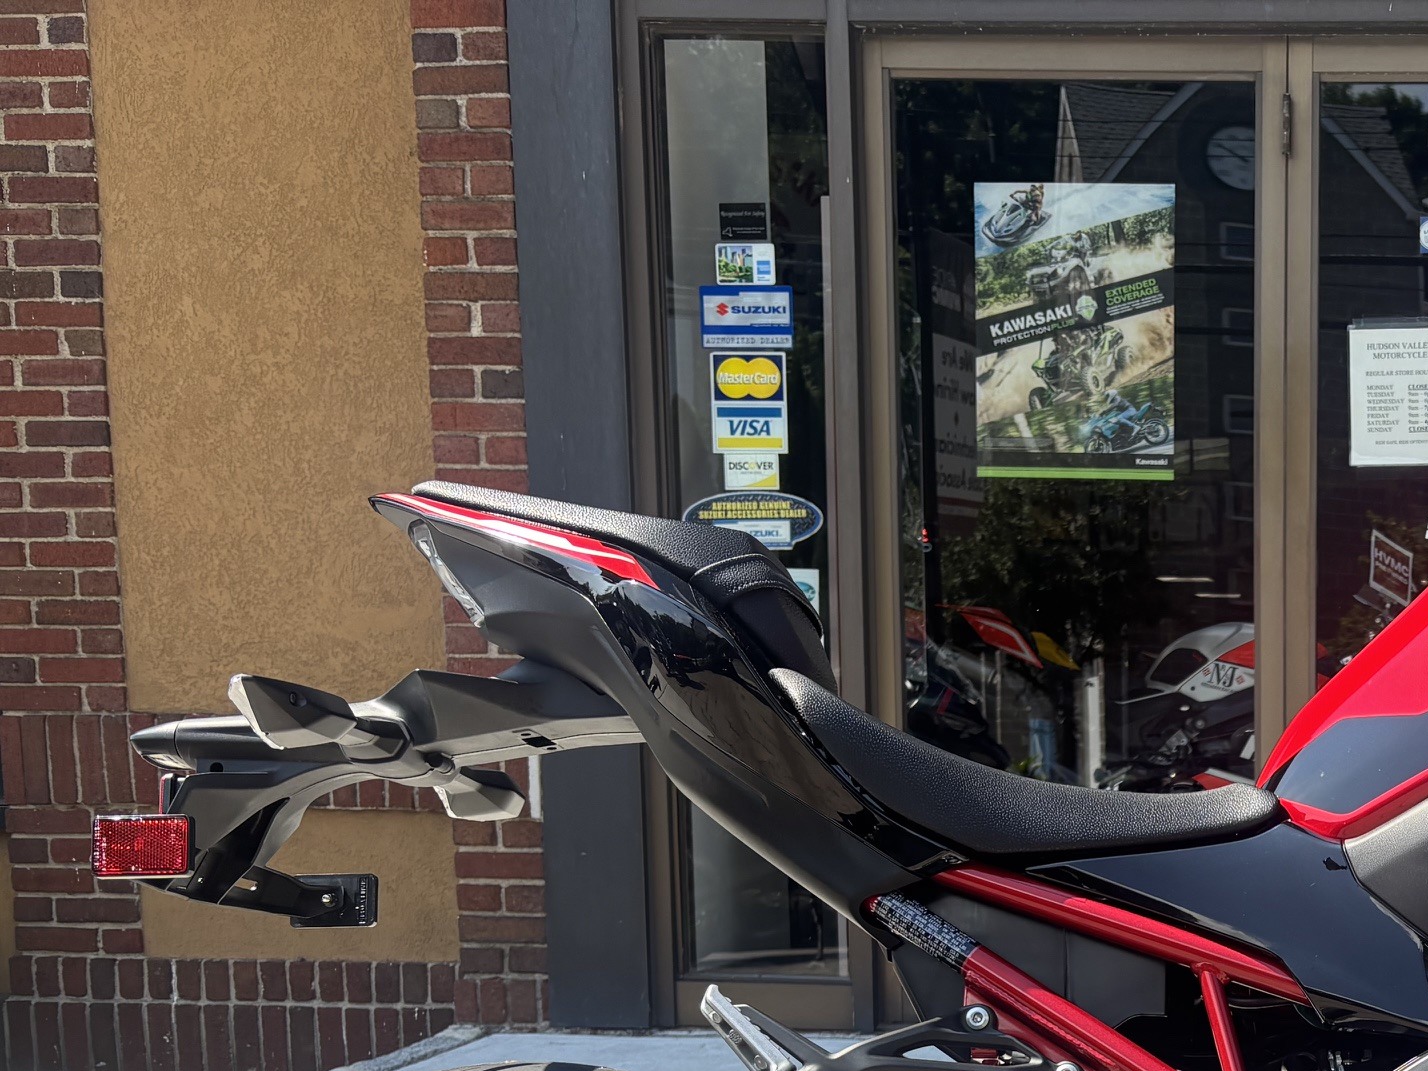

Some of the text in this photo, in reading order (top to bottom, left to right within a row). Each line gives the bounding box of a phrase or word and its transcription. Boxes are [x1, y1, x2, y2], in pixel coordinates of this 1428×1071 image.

[1104, 278, 1157, 299] EXTENDED
[1105, 286, 1161, 306] COVERAGE
[731, 305, 787, 315] SUZUKI
[989, 303, 1073, 338] KAWASAKI
[705, 337, 790, 345] AUTHORIZED DEALER
[1366, 342, 1400, 351] HUDSON
[1372, 351, 1428, 360] MOTORCYCLE
[718, 371, 779, 386] MasterCard
[728, 419, 772, 437] VISA
[728, 461, 775, 471] DISCOVER
[712, 500, 793, 511] AUTHORIZED GENUINE
[698, 508, 808, 520] SUZUKI ACCESSORIES DEALER
